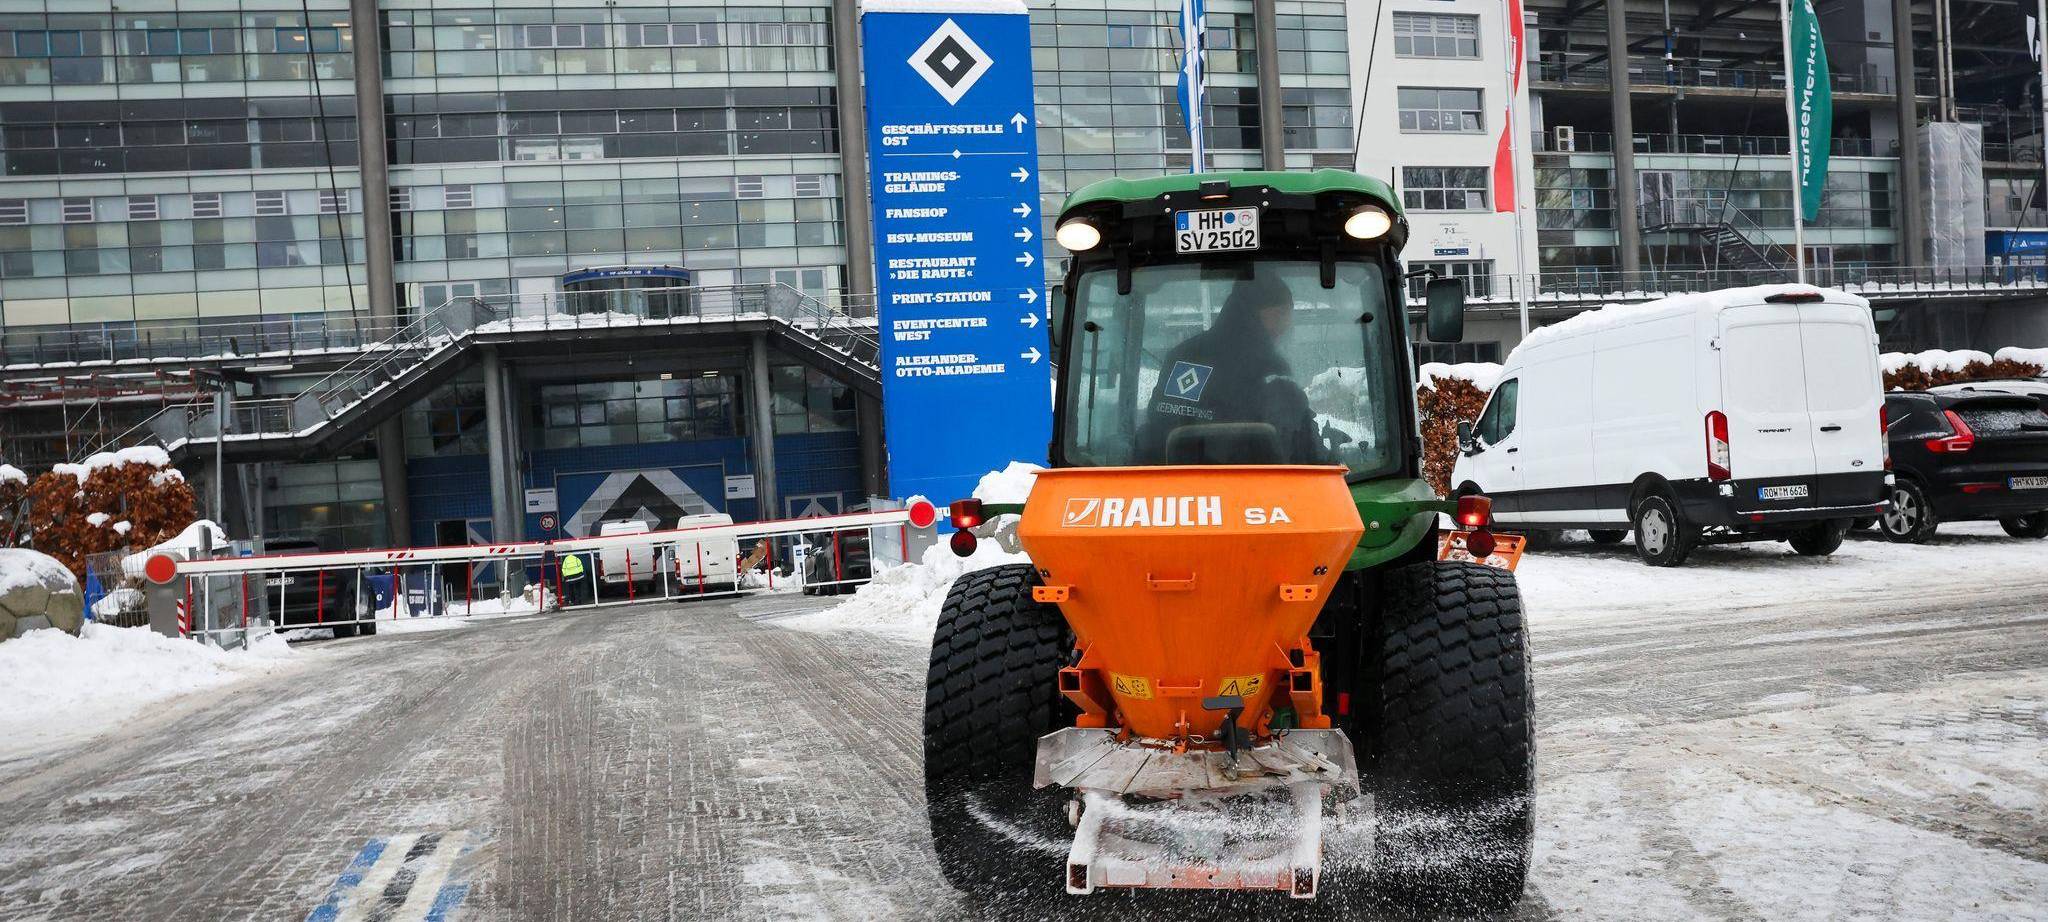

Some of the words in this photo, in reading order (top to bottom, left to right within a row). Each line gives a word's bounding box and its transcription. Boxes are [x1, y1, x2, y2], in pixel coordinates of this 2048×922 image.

[882, 123, 1003, 135] GESCHÄFTSSTELLE
[882, 136, 909, 146] OST
[884, 171, 960, 182] TRAININGS-
[884, 182, 945, 193] GELÄNDE
[886, 208, 948, 218] FANSHOP
[1199, 212, 1223, 229] HH
[887, 232, 973, 243] HSV-MUSEUM
[1181, 232, 1203, 250] SV
[1208, 229, 1255, 249] 2502
[889, 257, 976, 269] RESTAURANT
[892, 291, 991, 304] PRINT-STATION
[893, 318, 987, 330] EVENTCENTER
[894, 331, 931, 341] WEST
[896, 354, 979, 366] ALEXANDER-
[896, 364, 1005, 377] OTTO-AKADEMIE
[1764, 488, 1778, 498] ROW
[1783, 487, 1789, 497] M
[1789, 486, 1807, 496] 6626
[1100, 496, 1222, 527] RAUCH
[1244, 507, 1292, 524] SA
